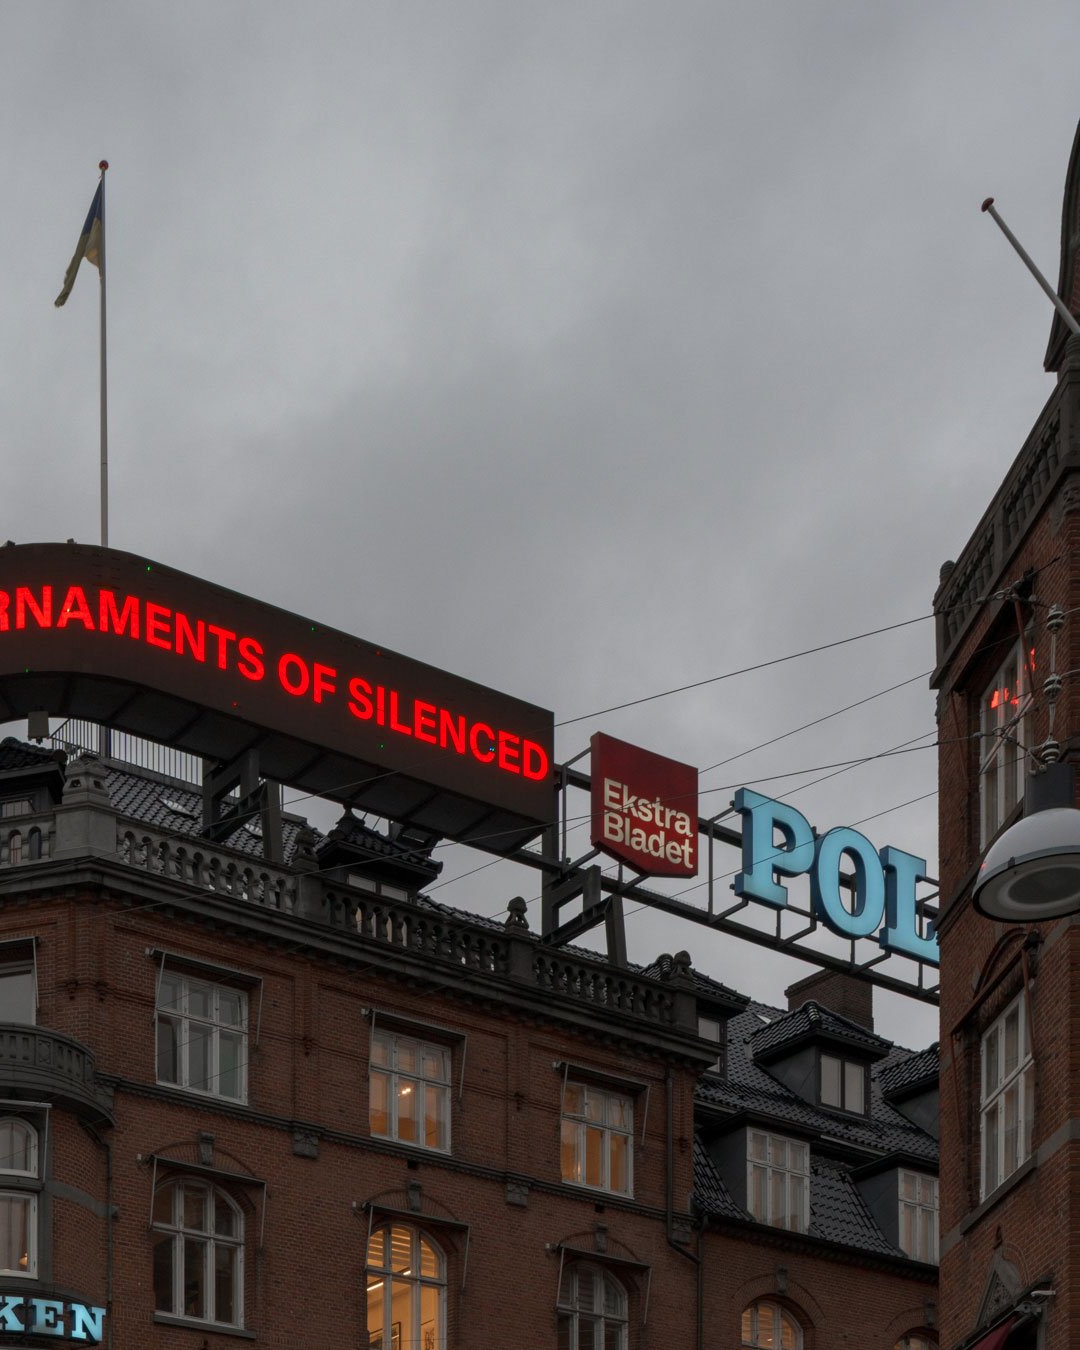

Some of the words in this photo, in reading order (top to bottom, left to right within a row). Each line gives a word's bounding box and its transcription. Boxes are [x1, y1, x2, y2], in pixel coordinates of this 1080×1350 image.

[277, 653, 337, 704] OF
[347, 677, 549, 781] SILENCED
[603, 777, 693, 838] Ekstra
[603, 811, 694, 869] Bladet
